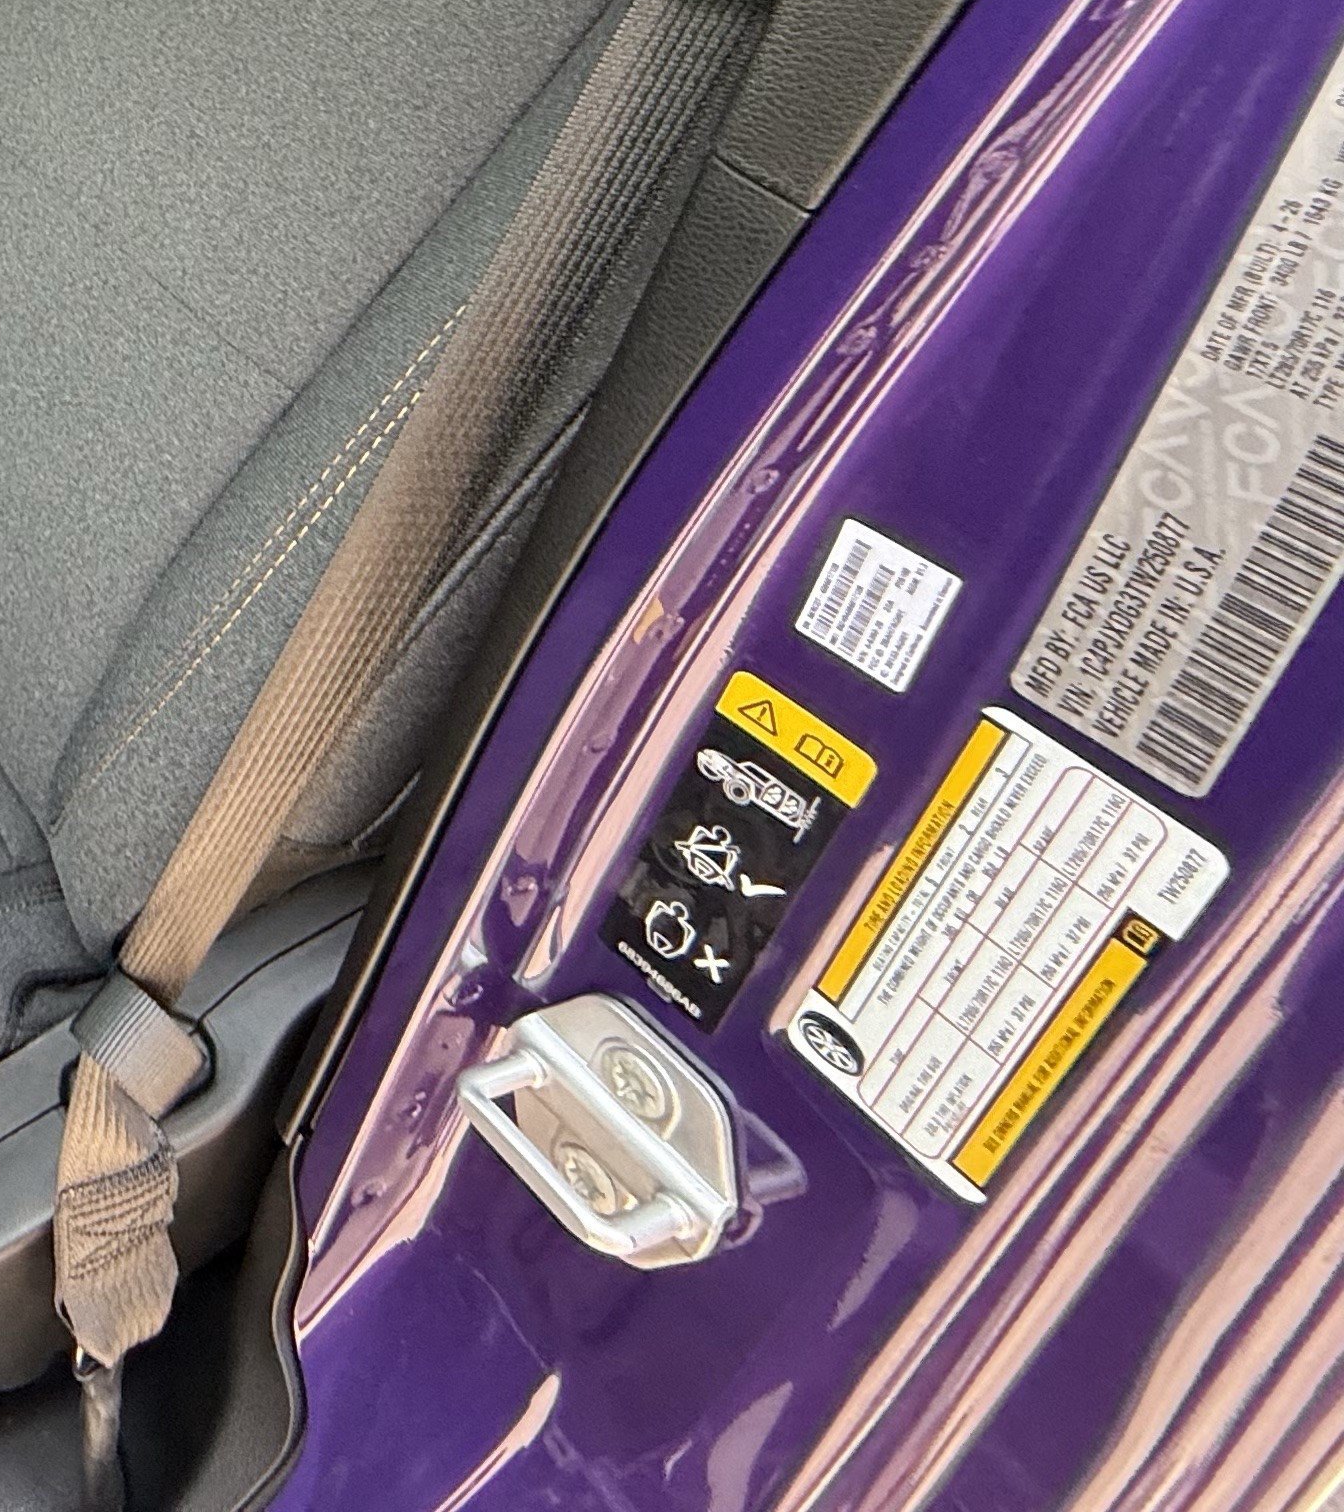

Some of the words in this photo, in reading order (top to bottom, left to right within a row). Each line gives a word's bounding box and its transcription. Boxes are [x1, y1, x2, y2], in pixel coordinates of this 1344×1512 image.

[1226, 285, 1255, 312] MFR
[1217, 312, 1237, 331] OF
[1199, 330, 1231, 362] DATE
[1224, 334, 1255, 371] GAWR
[1288, 380, 1310, 399] AT
[1092, 533, 1131, 570] LLC
[1079, 565, 1113, 595] US
[1173, 546, 1225, 597] U.S.A.
[1061, 592, 1100, 630] FCA
[1157, 596, 1193, 624] IN:
[1044, 629, 1079, 661] BY:
[1129, 620, 1177, 673] MADE
[1024, 656, 1062, 697] MFD
[1057, 683, 1095, 717] VIN:
[1092, 668, 1149, 738] VEHICLE
[958, 864, 975, 880] AND
[968, 836, 992, 865] CARGO
[1004, 783, 1027, 810] NEVER
[1019, 753, 1047, 786] EXCEED
[1157, 848, 1206, 904] TW250877
